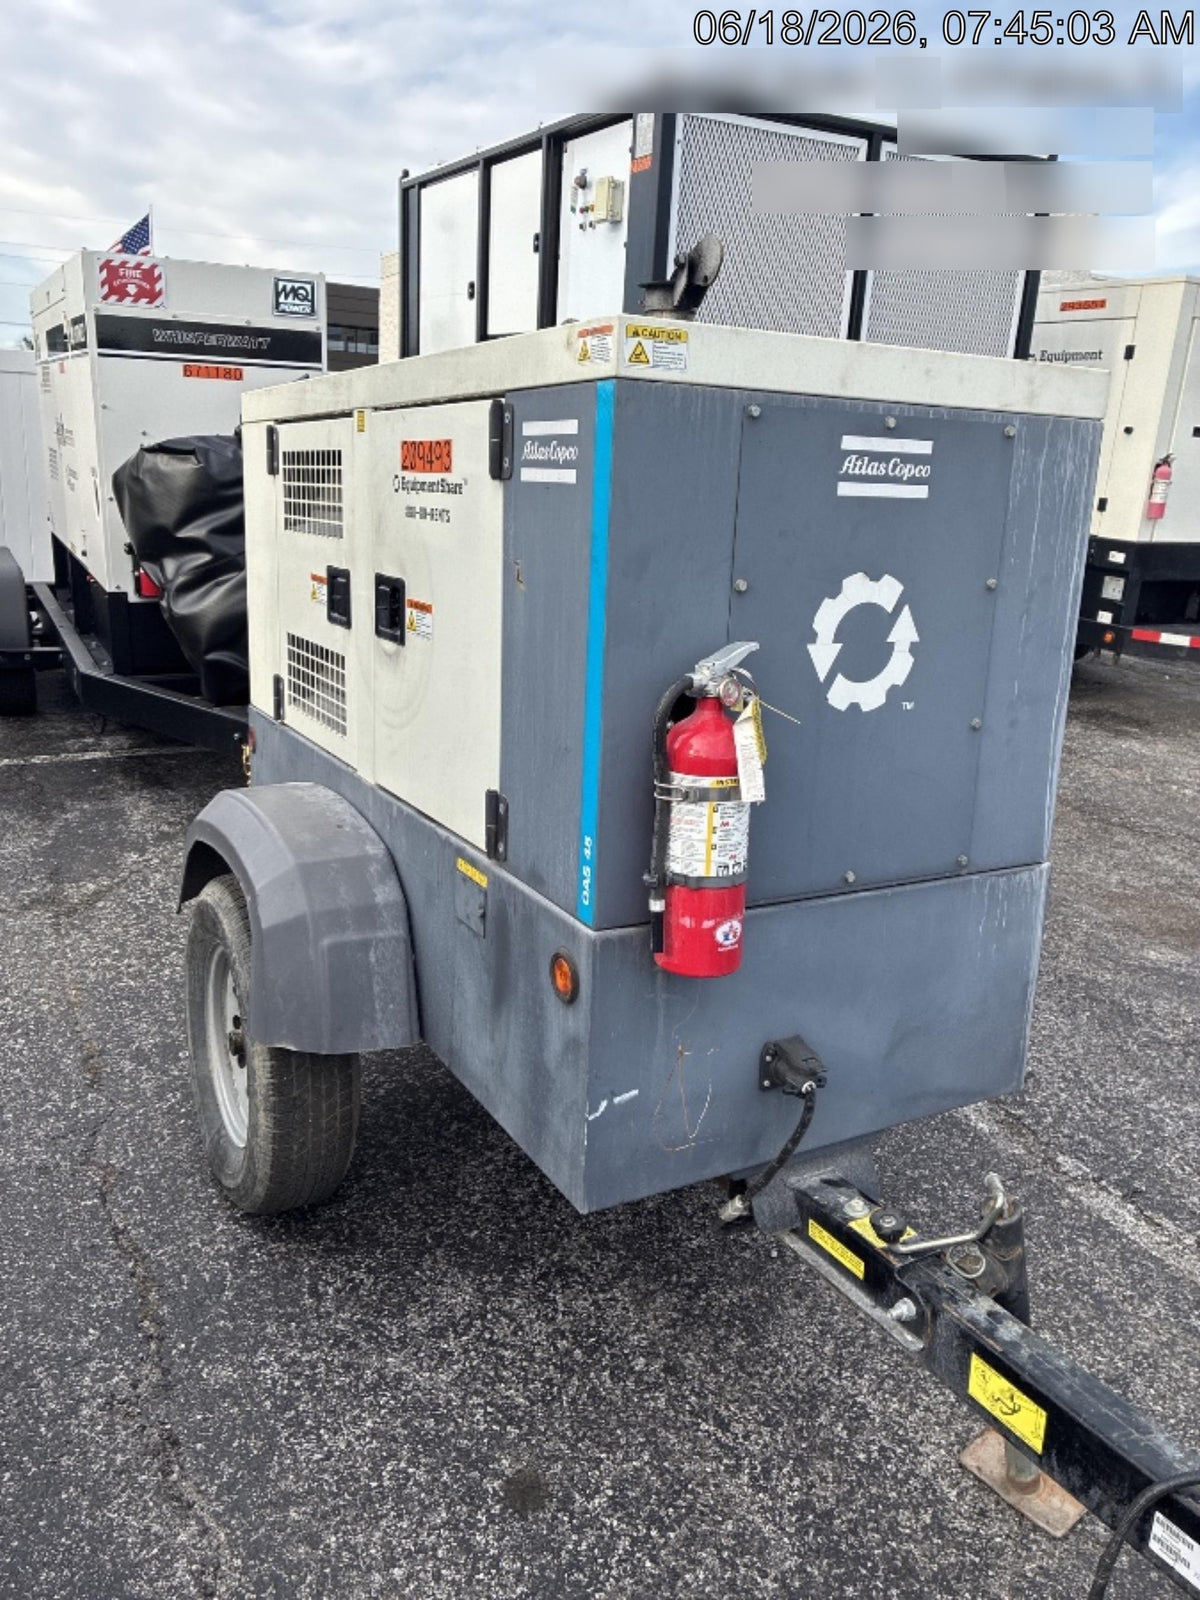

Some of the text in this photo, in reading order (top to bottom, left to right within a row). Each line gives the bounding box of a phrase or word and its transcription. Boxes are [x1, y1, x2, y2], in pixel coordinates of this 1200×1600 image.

[118, 268, 143, 278] FIRE
[277, 284, 312, 302] MQ
[279, 303, 312, 314] POWER
[152, 328, 271, 349] WHISPERWATT
[641, 328, 682, 341] CAUTION
[1039, 350, 1104, 364] Equipment
[183, 364, 243, 381] 671180
[839, 454, 931, 481] Atlas Copco
